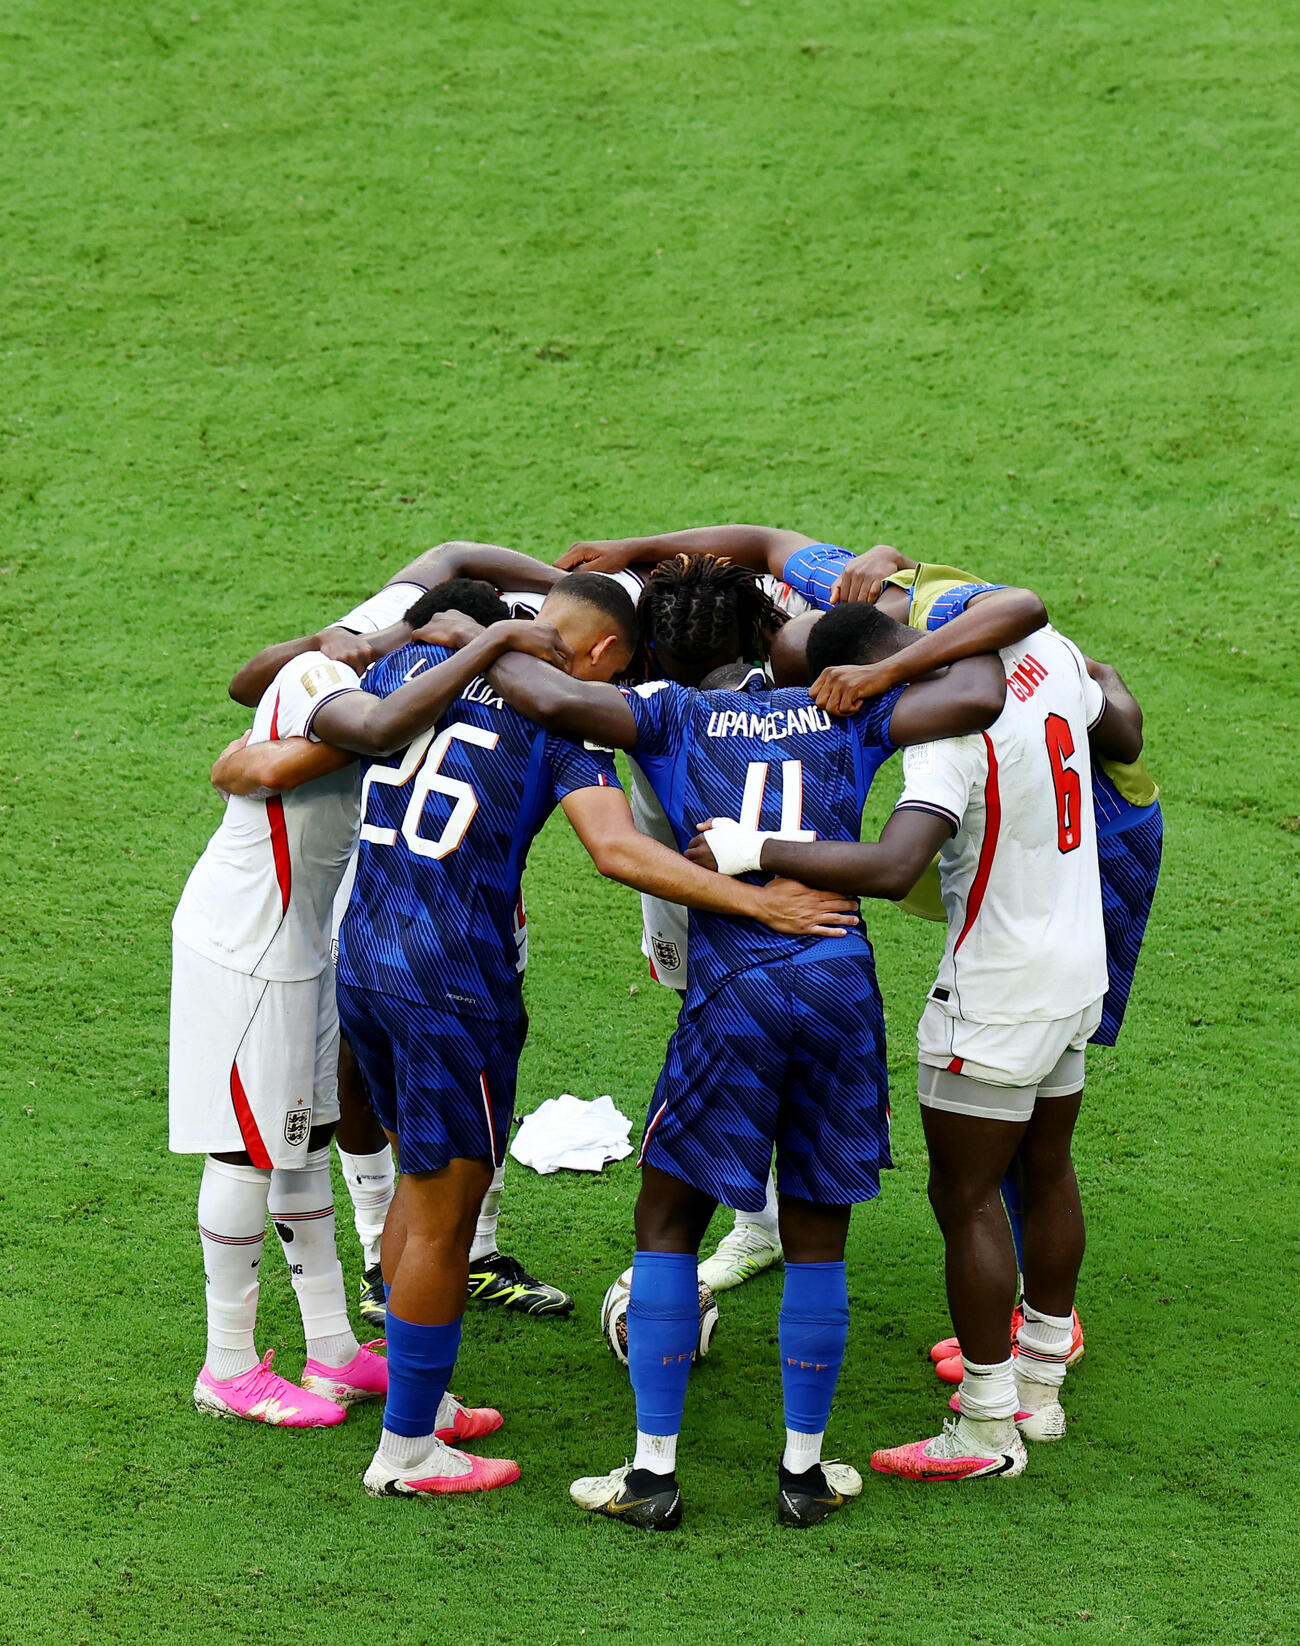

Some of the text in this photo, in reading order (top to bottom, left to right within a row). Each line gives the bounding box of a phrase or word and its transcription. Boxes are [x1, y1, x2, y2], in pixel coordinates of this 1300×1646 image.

[359, 721, 500, 860] 26
[707, 705, 832, 742] UPAMECANO
[1044, 712, 1081, 855] 6
